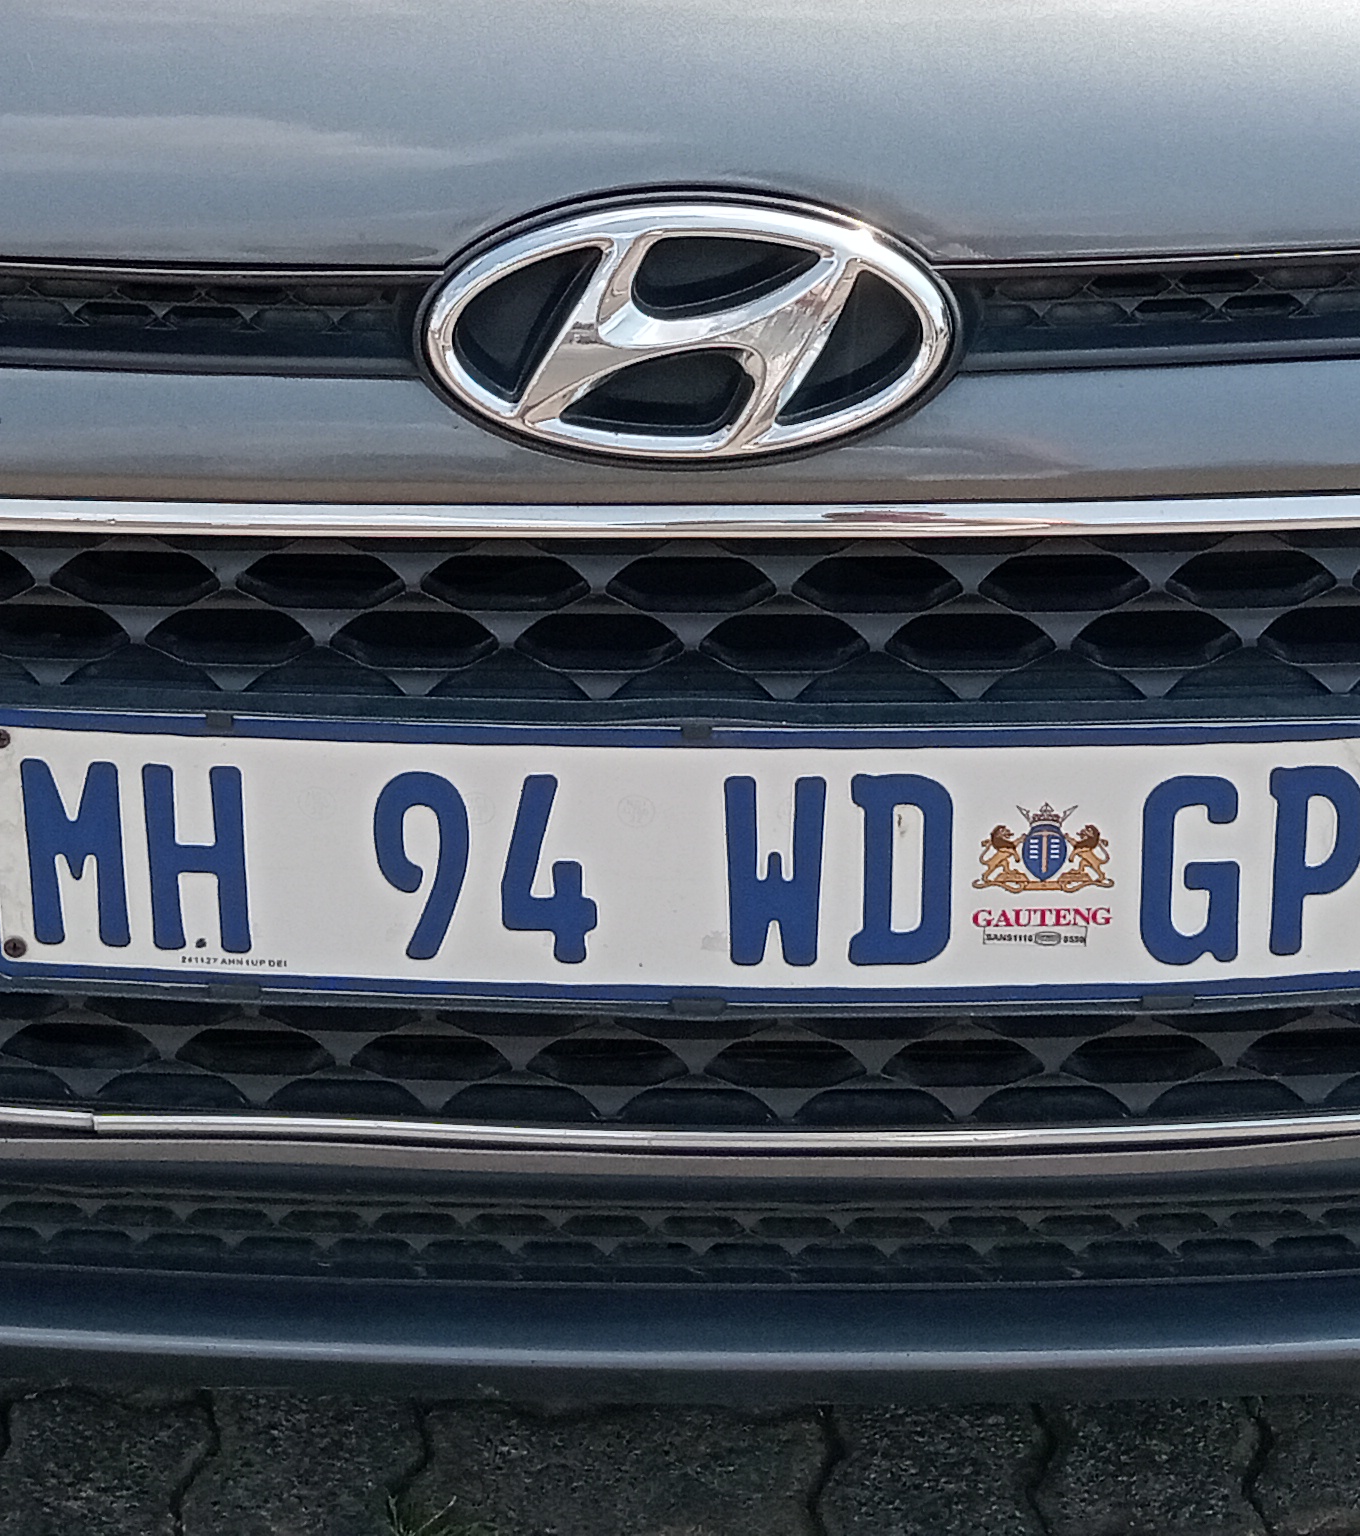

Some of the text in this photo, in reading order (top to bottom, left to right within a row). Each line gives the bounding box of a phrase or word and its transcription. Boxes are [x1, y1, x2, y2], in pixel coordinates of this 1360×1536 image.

[20, 757, 252, 954] MH
[373, 770, 598, 964] 94
[724, 773, 955, 966] WD
[971, 906, 1113, 928] GAUTENG
